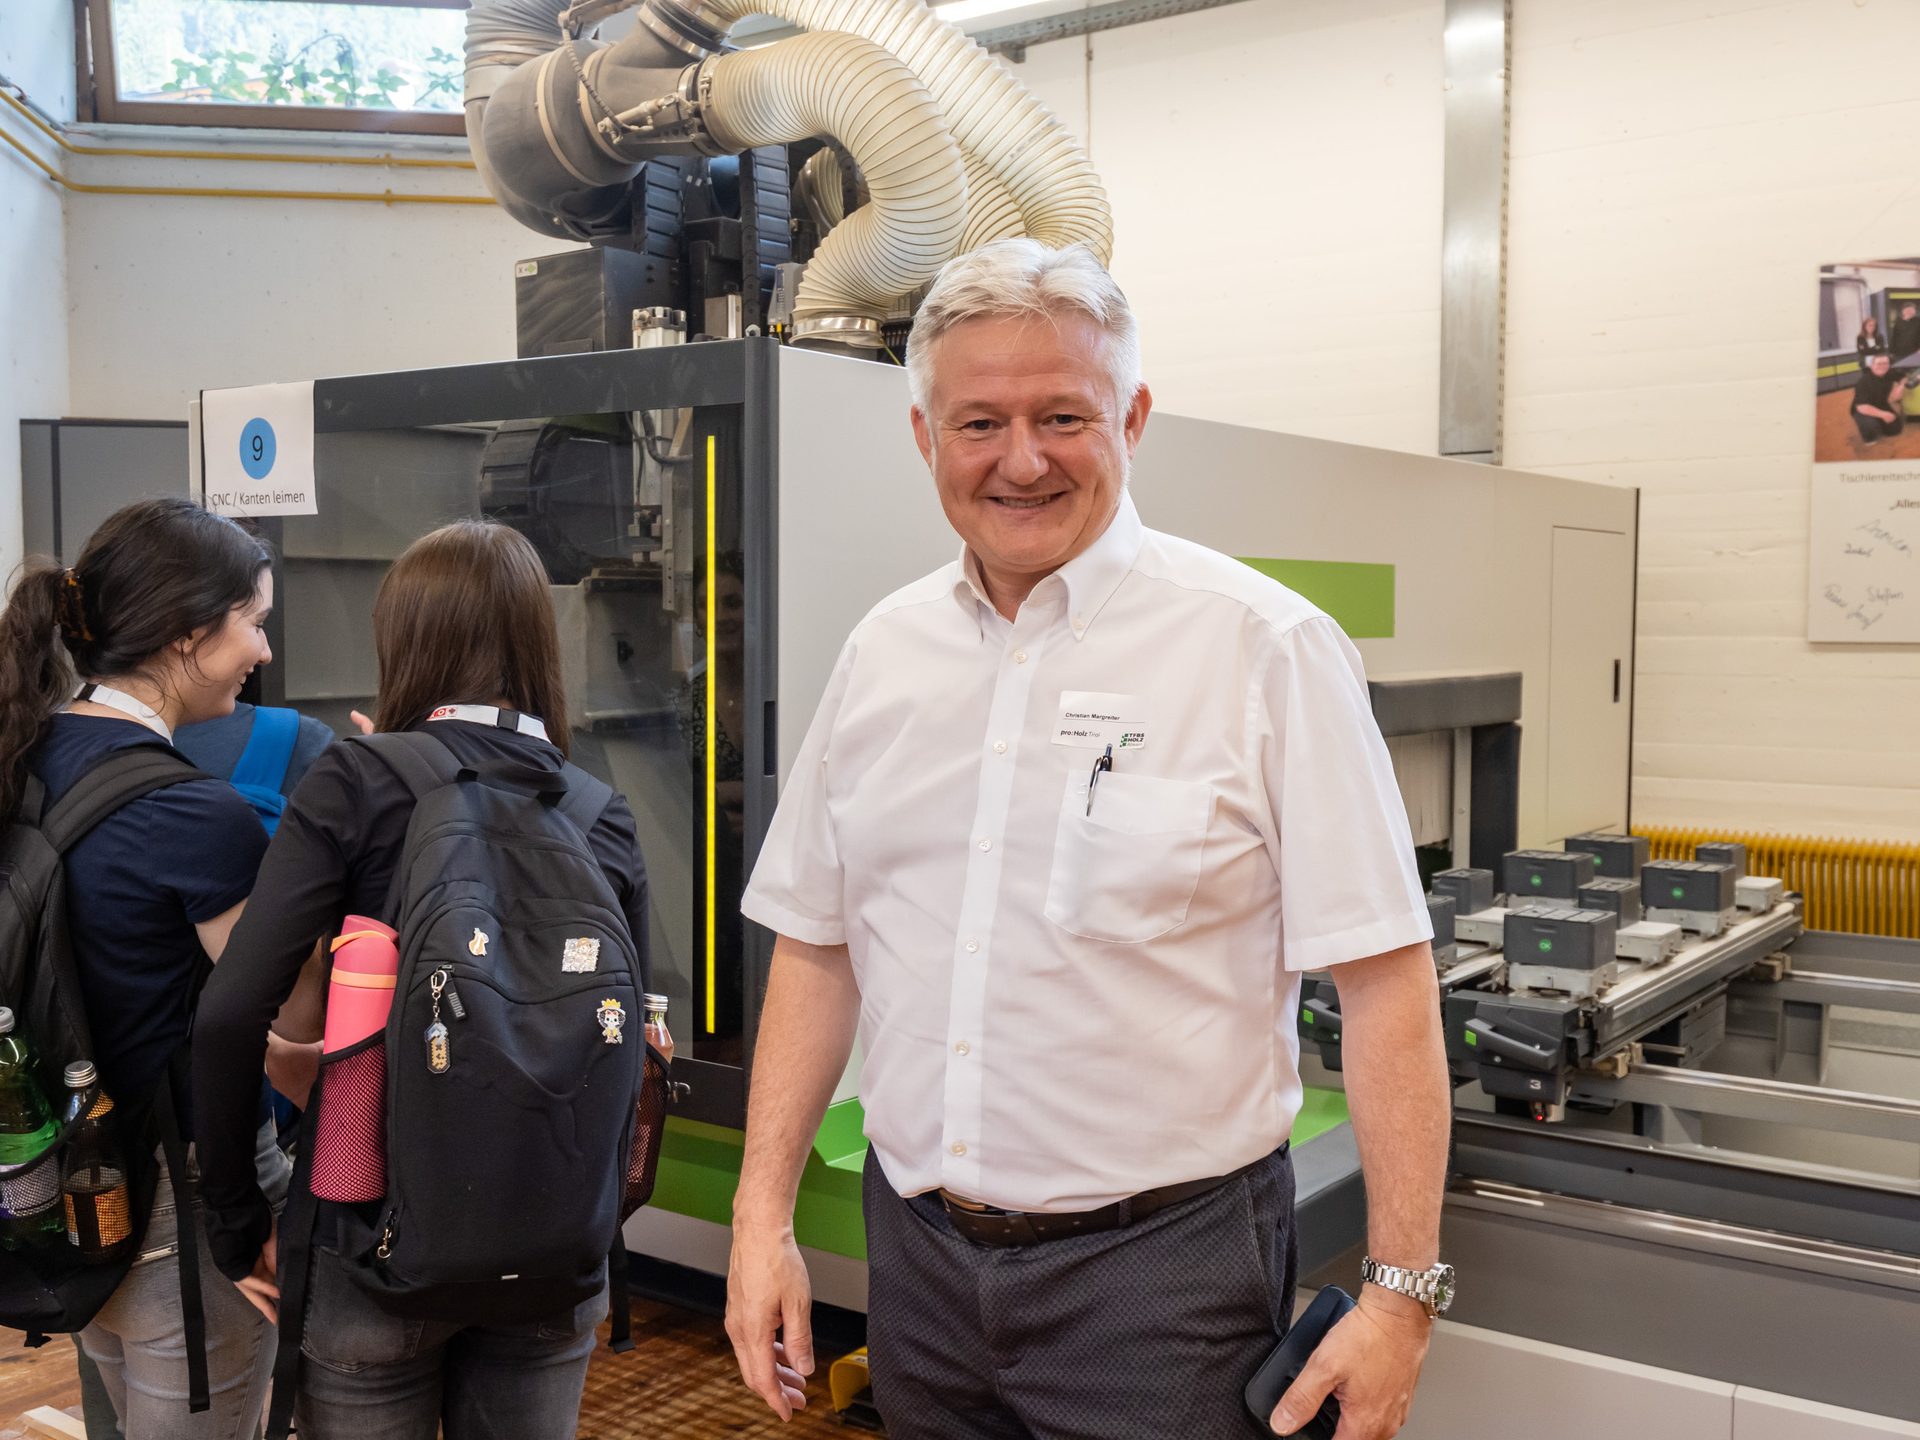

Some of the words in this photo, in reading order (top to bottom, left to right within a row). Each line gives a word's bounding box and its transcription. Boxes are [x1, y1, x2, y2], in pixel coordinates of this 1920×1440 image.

[252, 435, 263, 461] 9
[211, 493, 231, 506] CNC
[240, 492, 271, 505] Kanten
[273, 490, 306, 503] leimen
[1538, 942, 1551, 951] OK
[448, 992, 466, 1018] PUMA
[1530, 1079, 1541, 1090] 3
